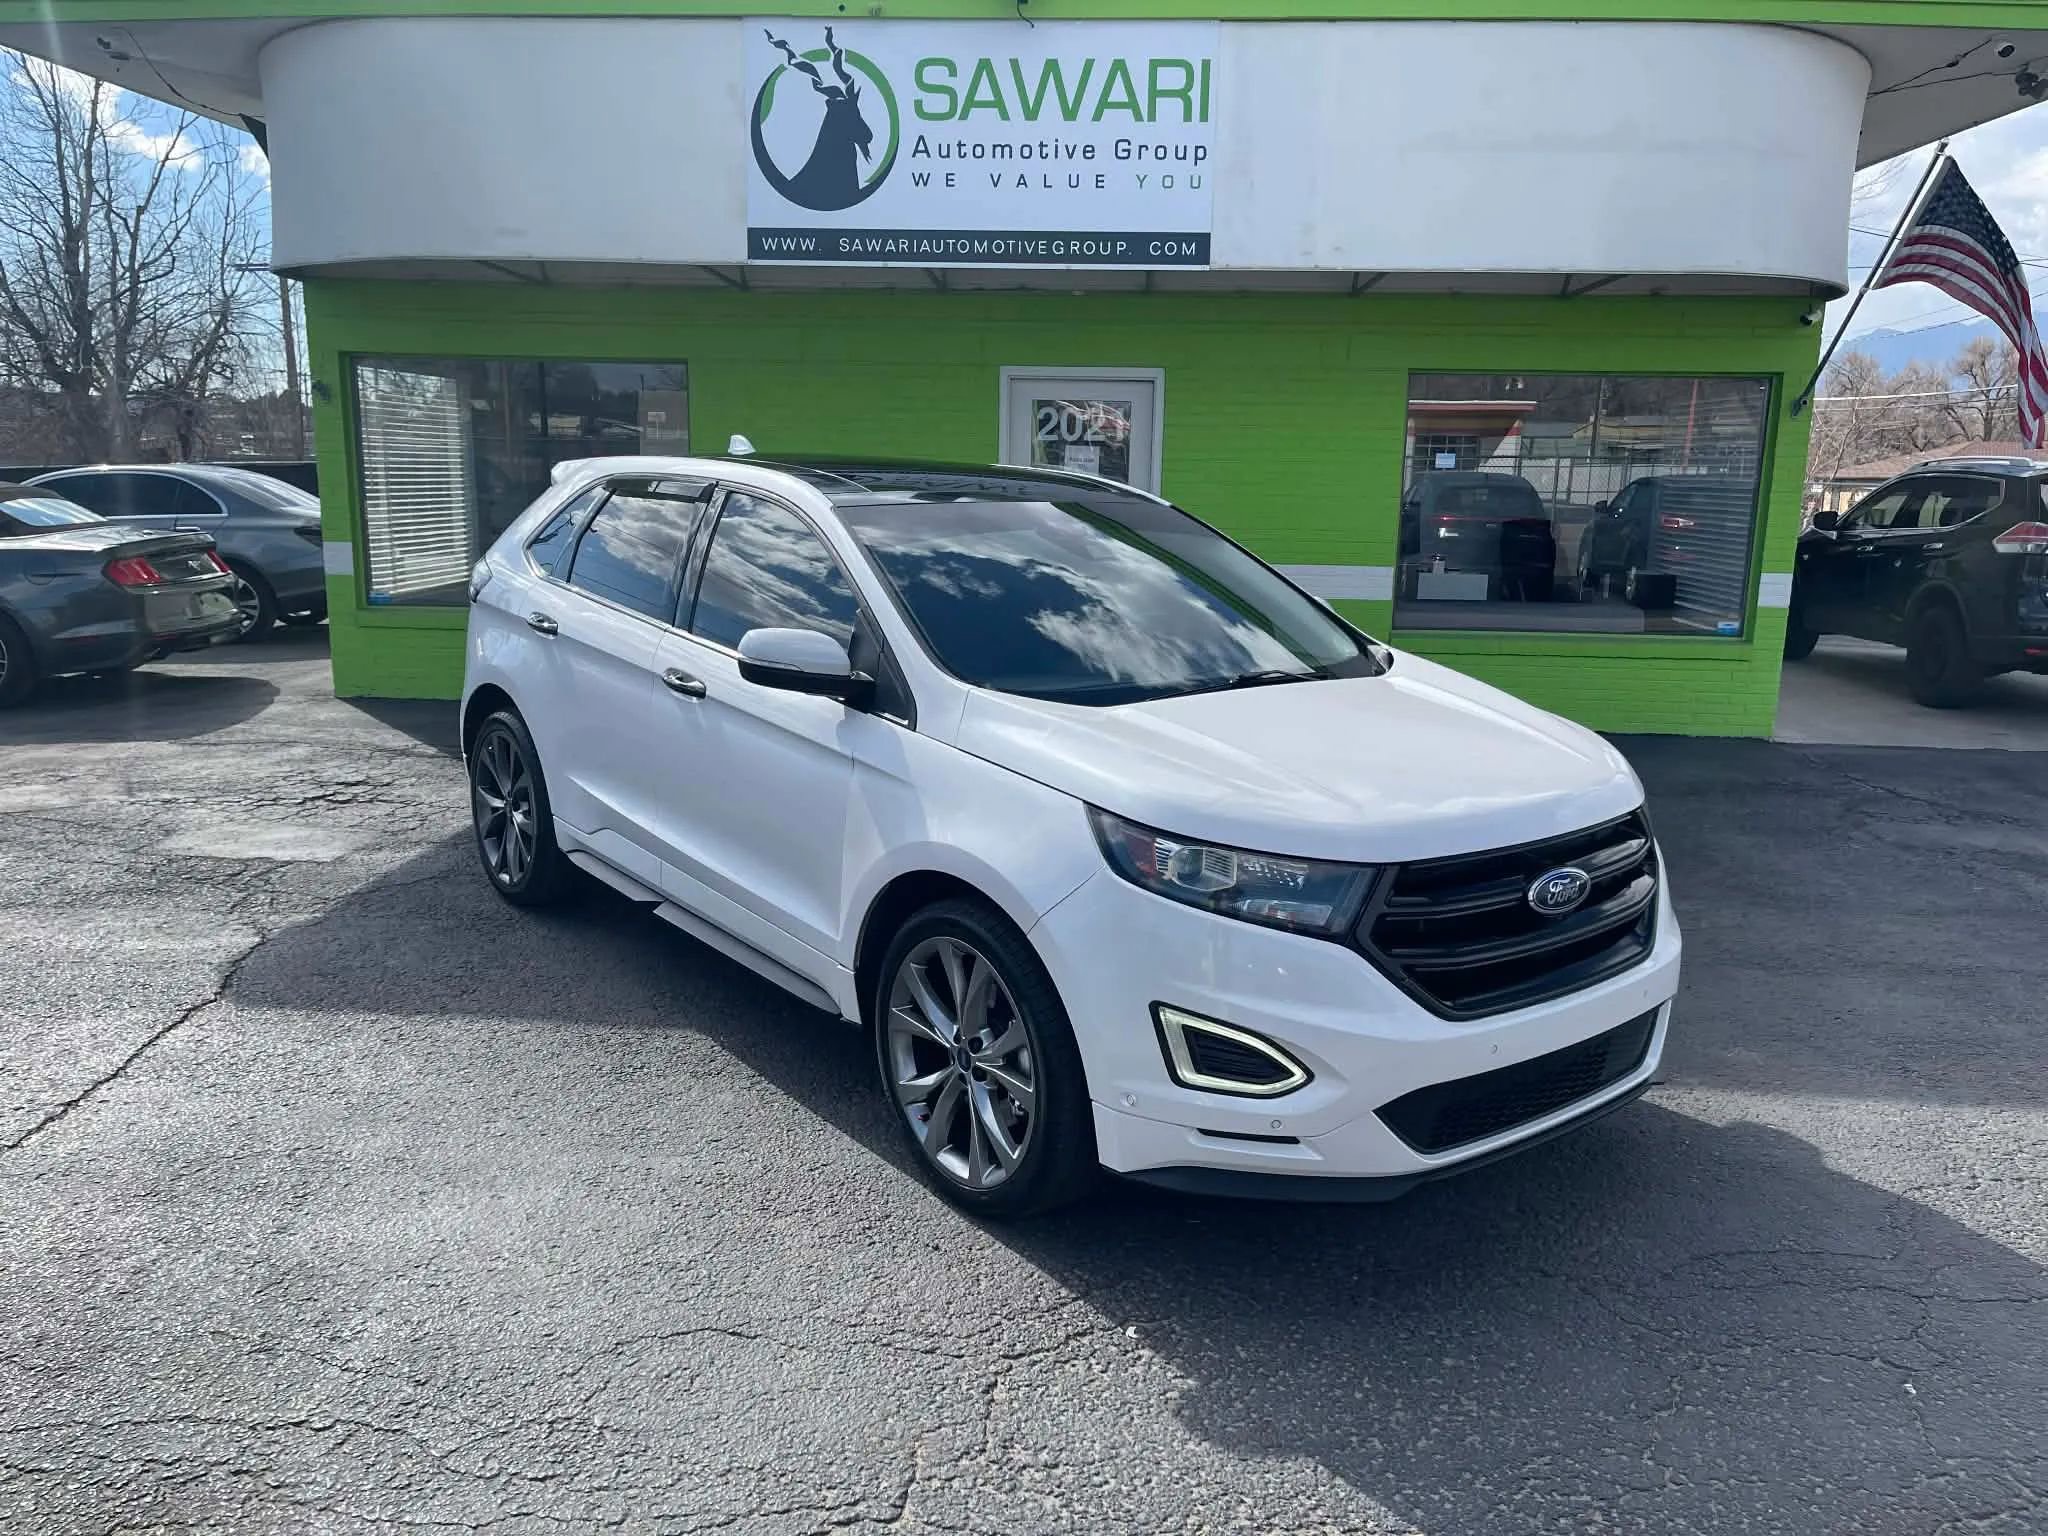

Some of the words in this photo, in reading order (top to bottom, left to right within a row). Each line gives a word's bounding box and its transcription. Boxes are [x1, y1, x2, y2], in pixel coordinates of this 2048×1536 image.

[913, 57, 1212, 123] SAWARI
[911, 134, 1096, 160] Automotive
[1114, 138, 1208, 166] Group
[911, 172, 957, 188] WE
[989, 173, 1106, 189] VALUE
[1135, 174, 1202, 190] YOU
[1149, 241, 1197, 256] COM
[1547, 877, 1580, 905] Ford
